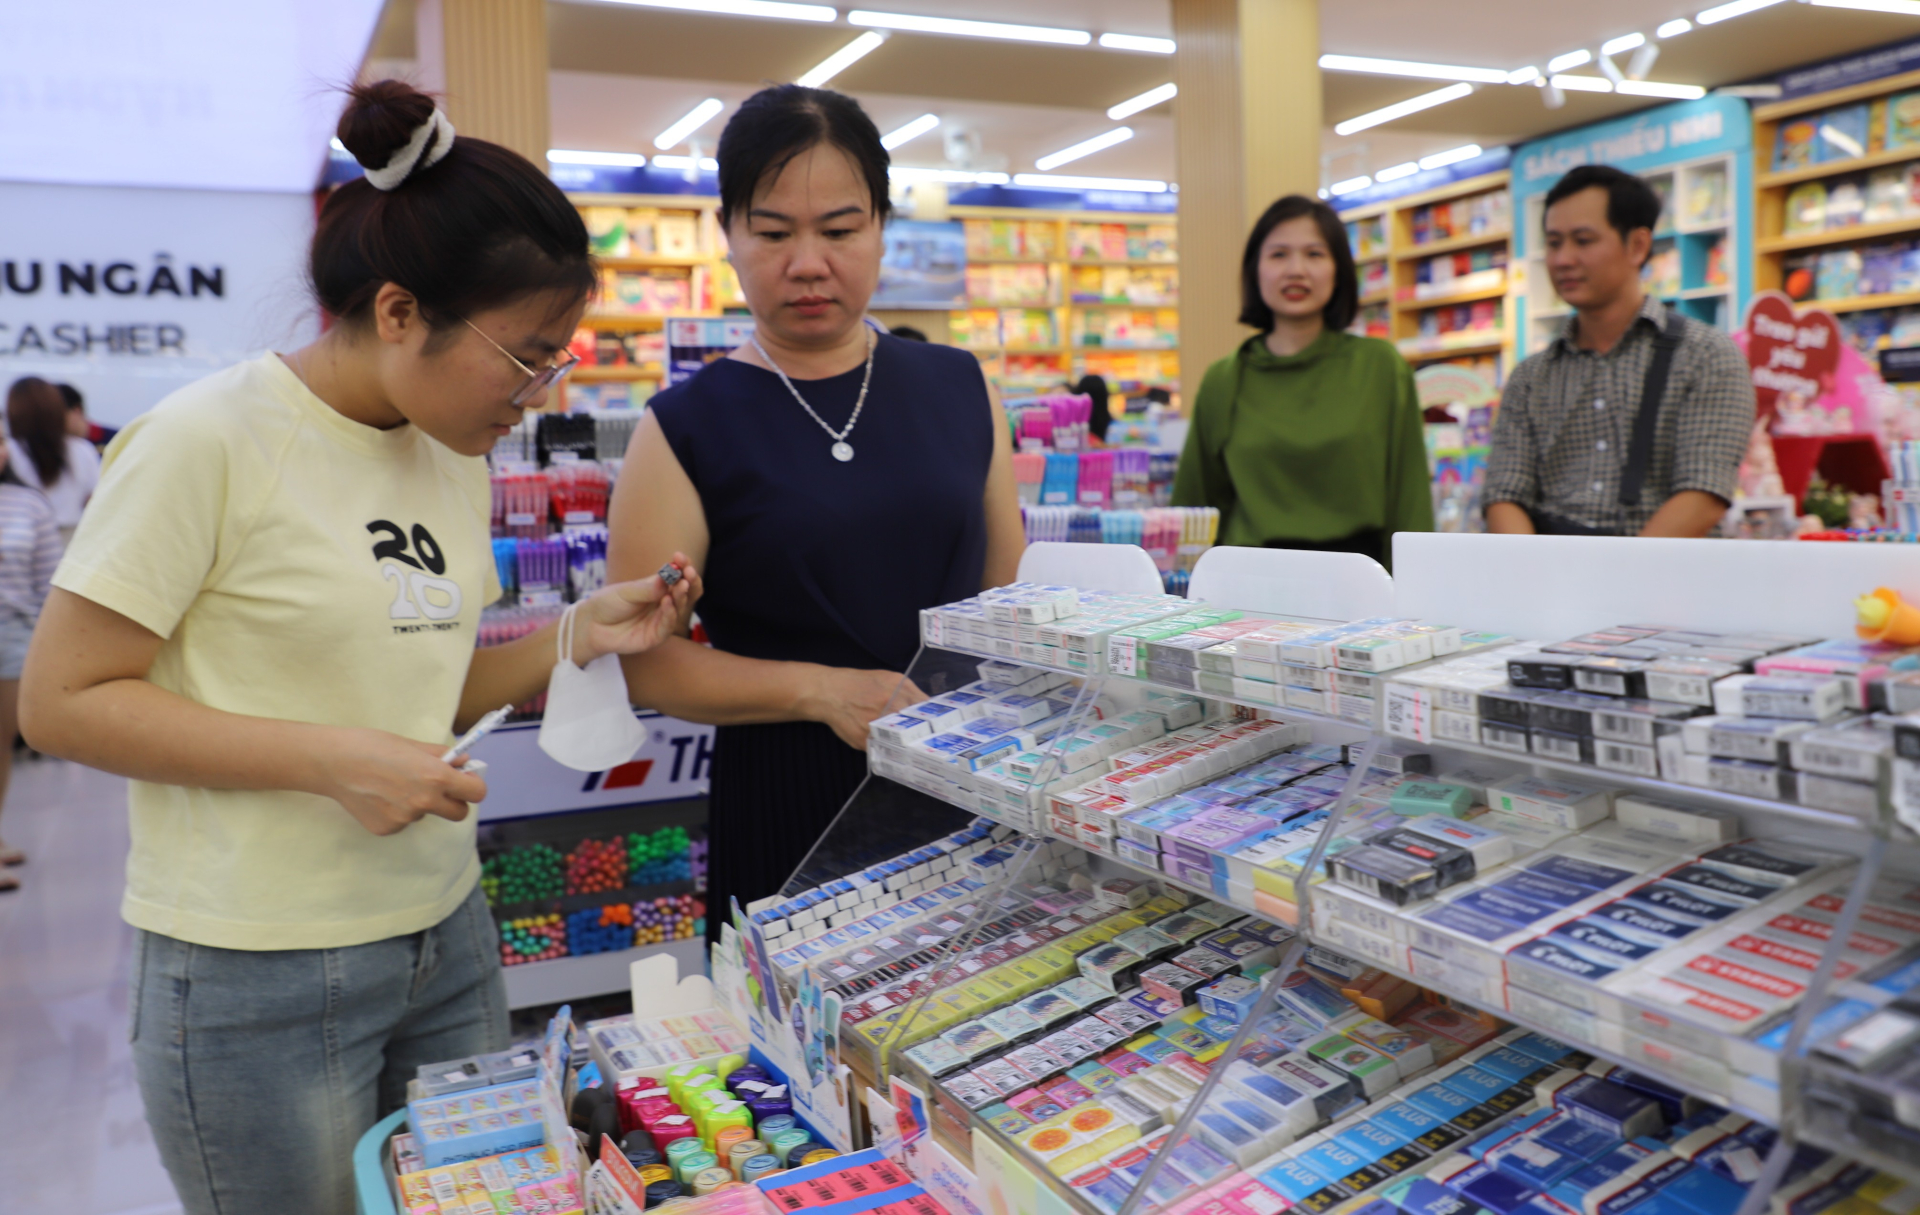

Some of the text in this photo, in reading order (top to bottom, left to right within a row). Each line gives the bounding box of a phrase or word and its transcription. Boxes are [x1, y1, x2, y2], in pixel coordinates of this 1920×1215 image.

[0, 252, 225, 298] U NGÂN
[366, 519, 446, 576] 20
[1704, 877, 1753, 894] PILOT
[1667, 895, 1716, 914] PILOT
[1626, 914, 1677, 933] PILOT
[1586, 933, 1637, 953] PILOT
[1545, 952, 1596, 974] PILOT
[1493, 1049, 1535, 1068] PLUS
[1460, 1067, 1502, 1088] PLUS
[1426, 1084, 1468, 1107] PLUS
[1390, 1103, 1432, 1127] PLUS
[1354, 1122, 1396, 1146] PLUS
[1315, 1140, 1359, 1166] PLUS
[1278, 1160, 1320, 1186] PLUS
